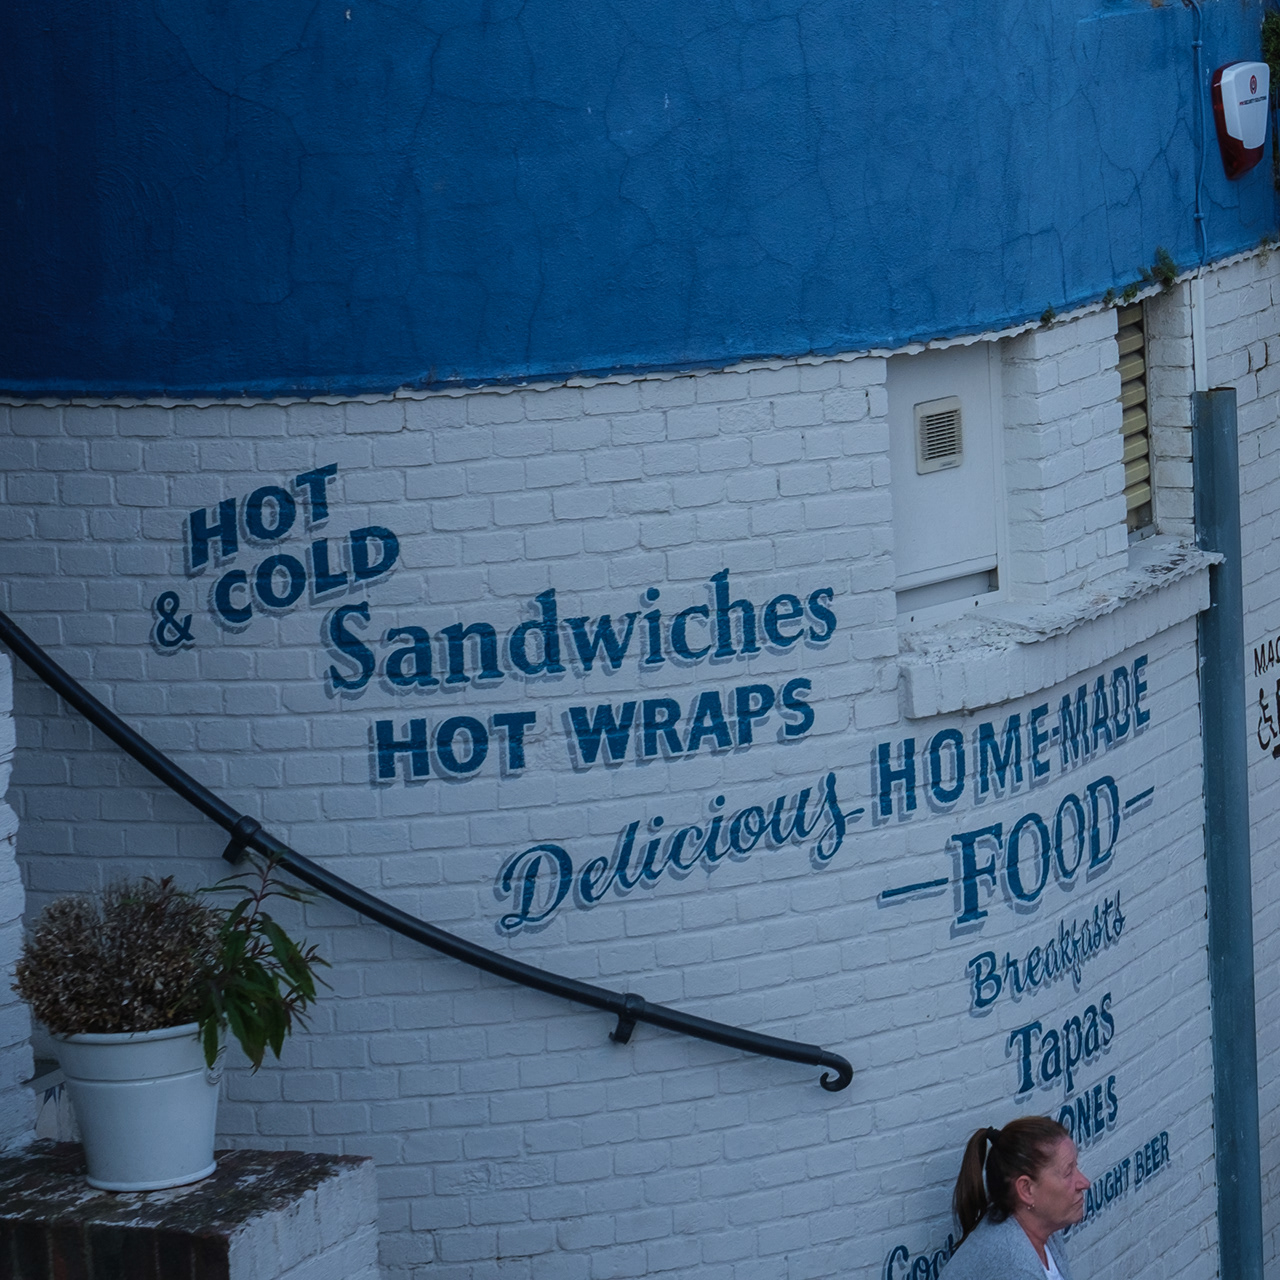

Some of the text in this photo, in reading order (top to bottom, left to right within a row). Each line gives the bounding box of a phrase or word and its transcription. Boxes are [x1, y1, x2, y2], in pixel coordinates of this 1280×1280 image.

[188, 462, 338, 569] HOT
[154, 524, 401, 648] & COLD
[328, 568, 838, 691] Sandwiches
[374, 678, 816, 779] HOT WRAPS
[877, 654, 1152, 817] HOME-MADE
[499, 771, 865, 929] Delicious
[950, 775, 1122, 924] FOOD
[968, 890, 1127, 1009] Breakfasts
[1009, 993, 1117, 1095] Tapas
[1133, 1131, 1171, 1190] BEER
